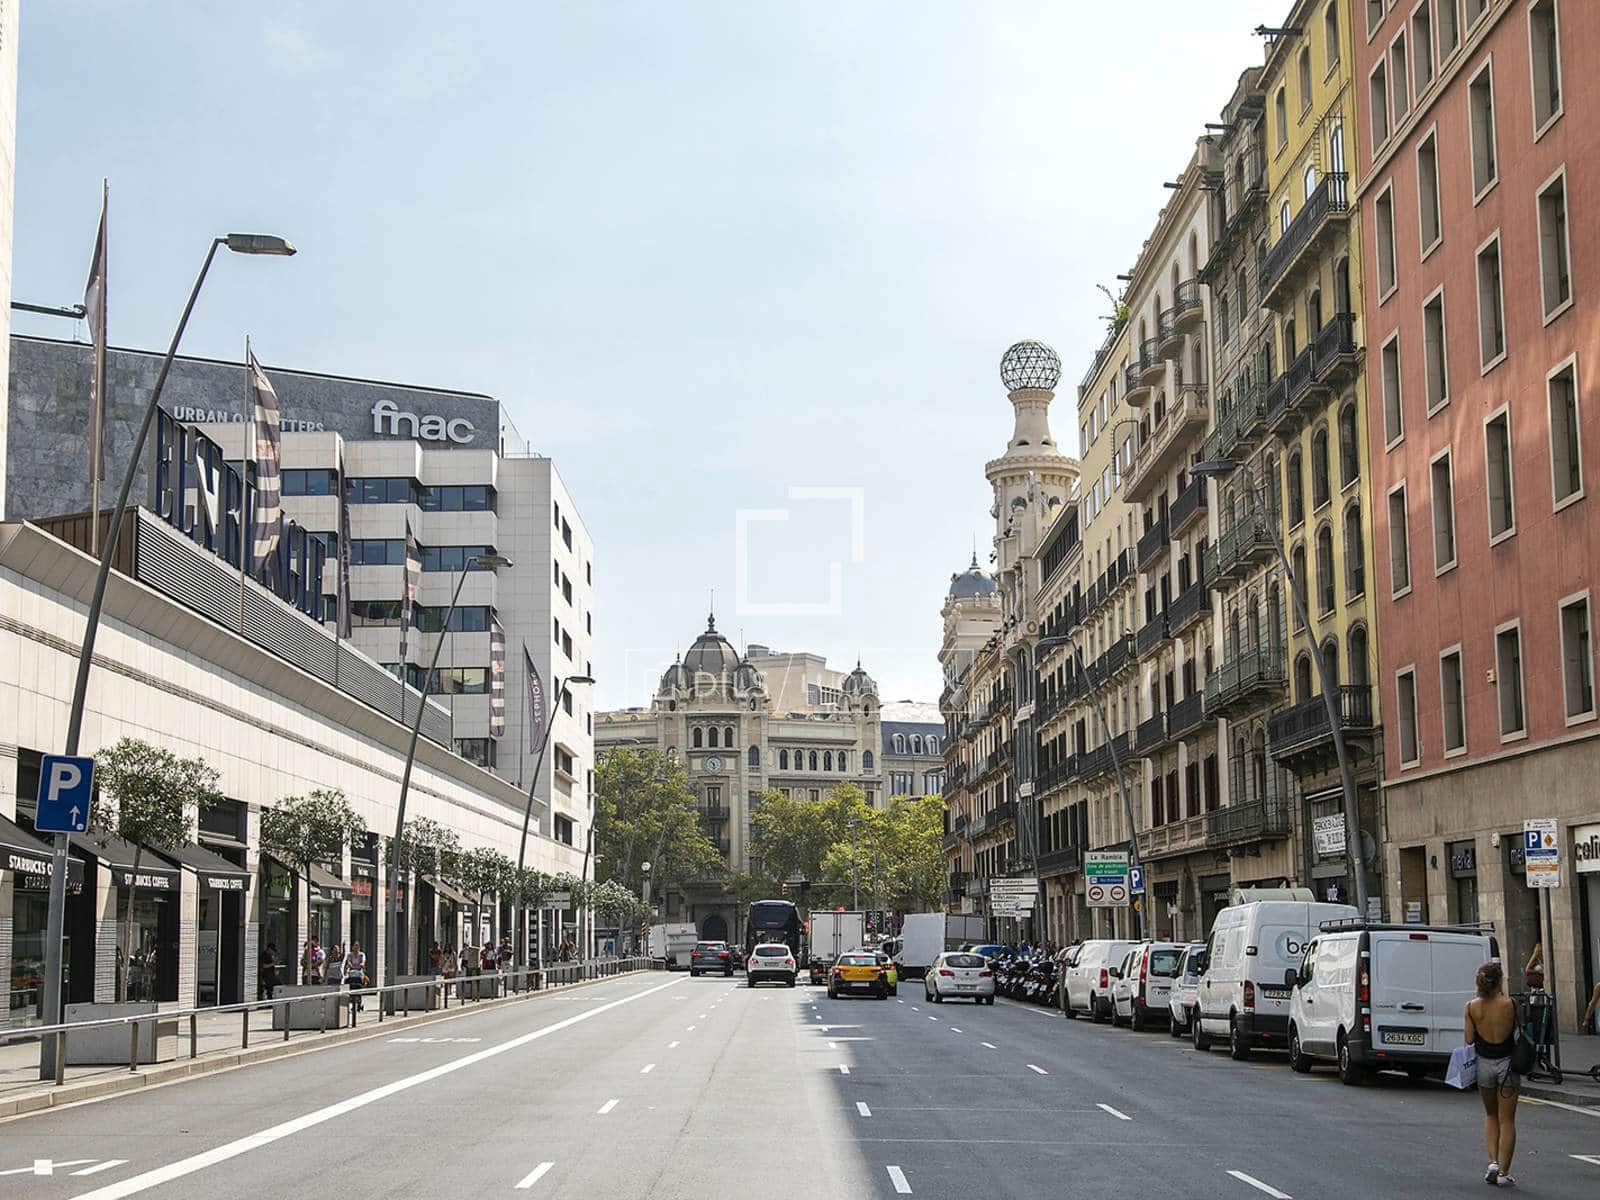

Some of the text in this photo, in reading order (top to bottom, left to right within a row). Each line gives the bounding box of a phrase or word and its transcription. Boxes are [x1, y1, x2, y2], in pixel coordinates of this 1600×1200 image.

[173, 405, 228, 424] URBAN
[371, 399, 475, 444] fnac
[48, 762, 82, 801] P
[1528, 832, 1538, 848] P
[1575, 835, 1600, 861] celi
[8, 854, 47, 876] STARBUCKS
[1131, 869, 1140, 888] P
